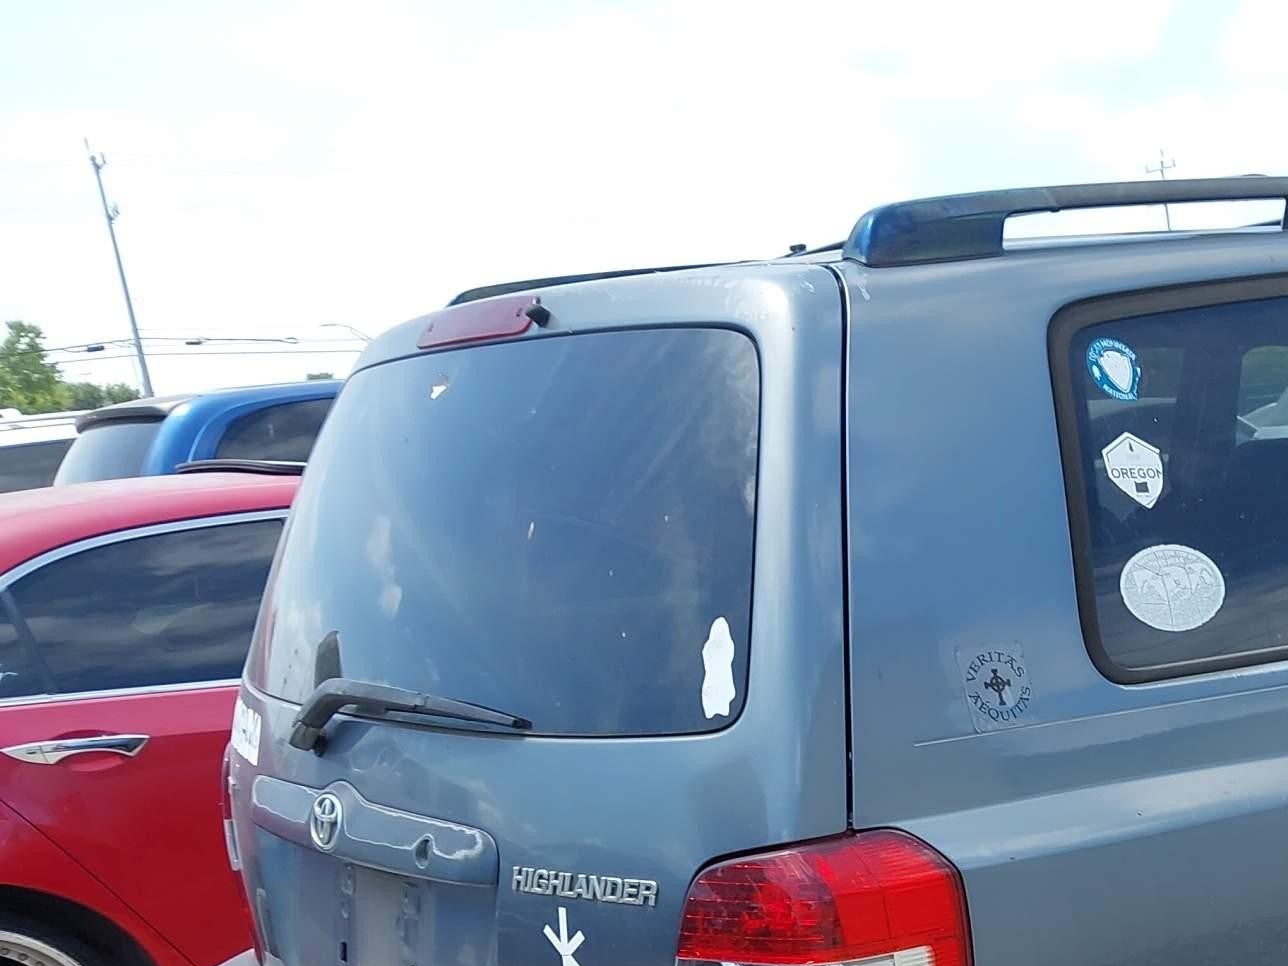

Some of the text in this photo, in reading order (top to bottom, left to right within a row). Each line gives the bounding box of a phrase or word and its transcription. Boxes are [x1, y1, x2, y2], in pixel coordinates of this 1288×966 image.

[966, 651, 1025, 683] VERITAS
[968, 686, 1031, 722] AEQUITAS
[512, 865, 658, 907] HIGHLANDER
